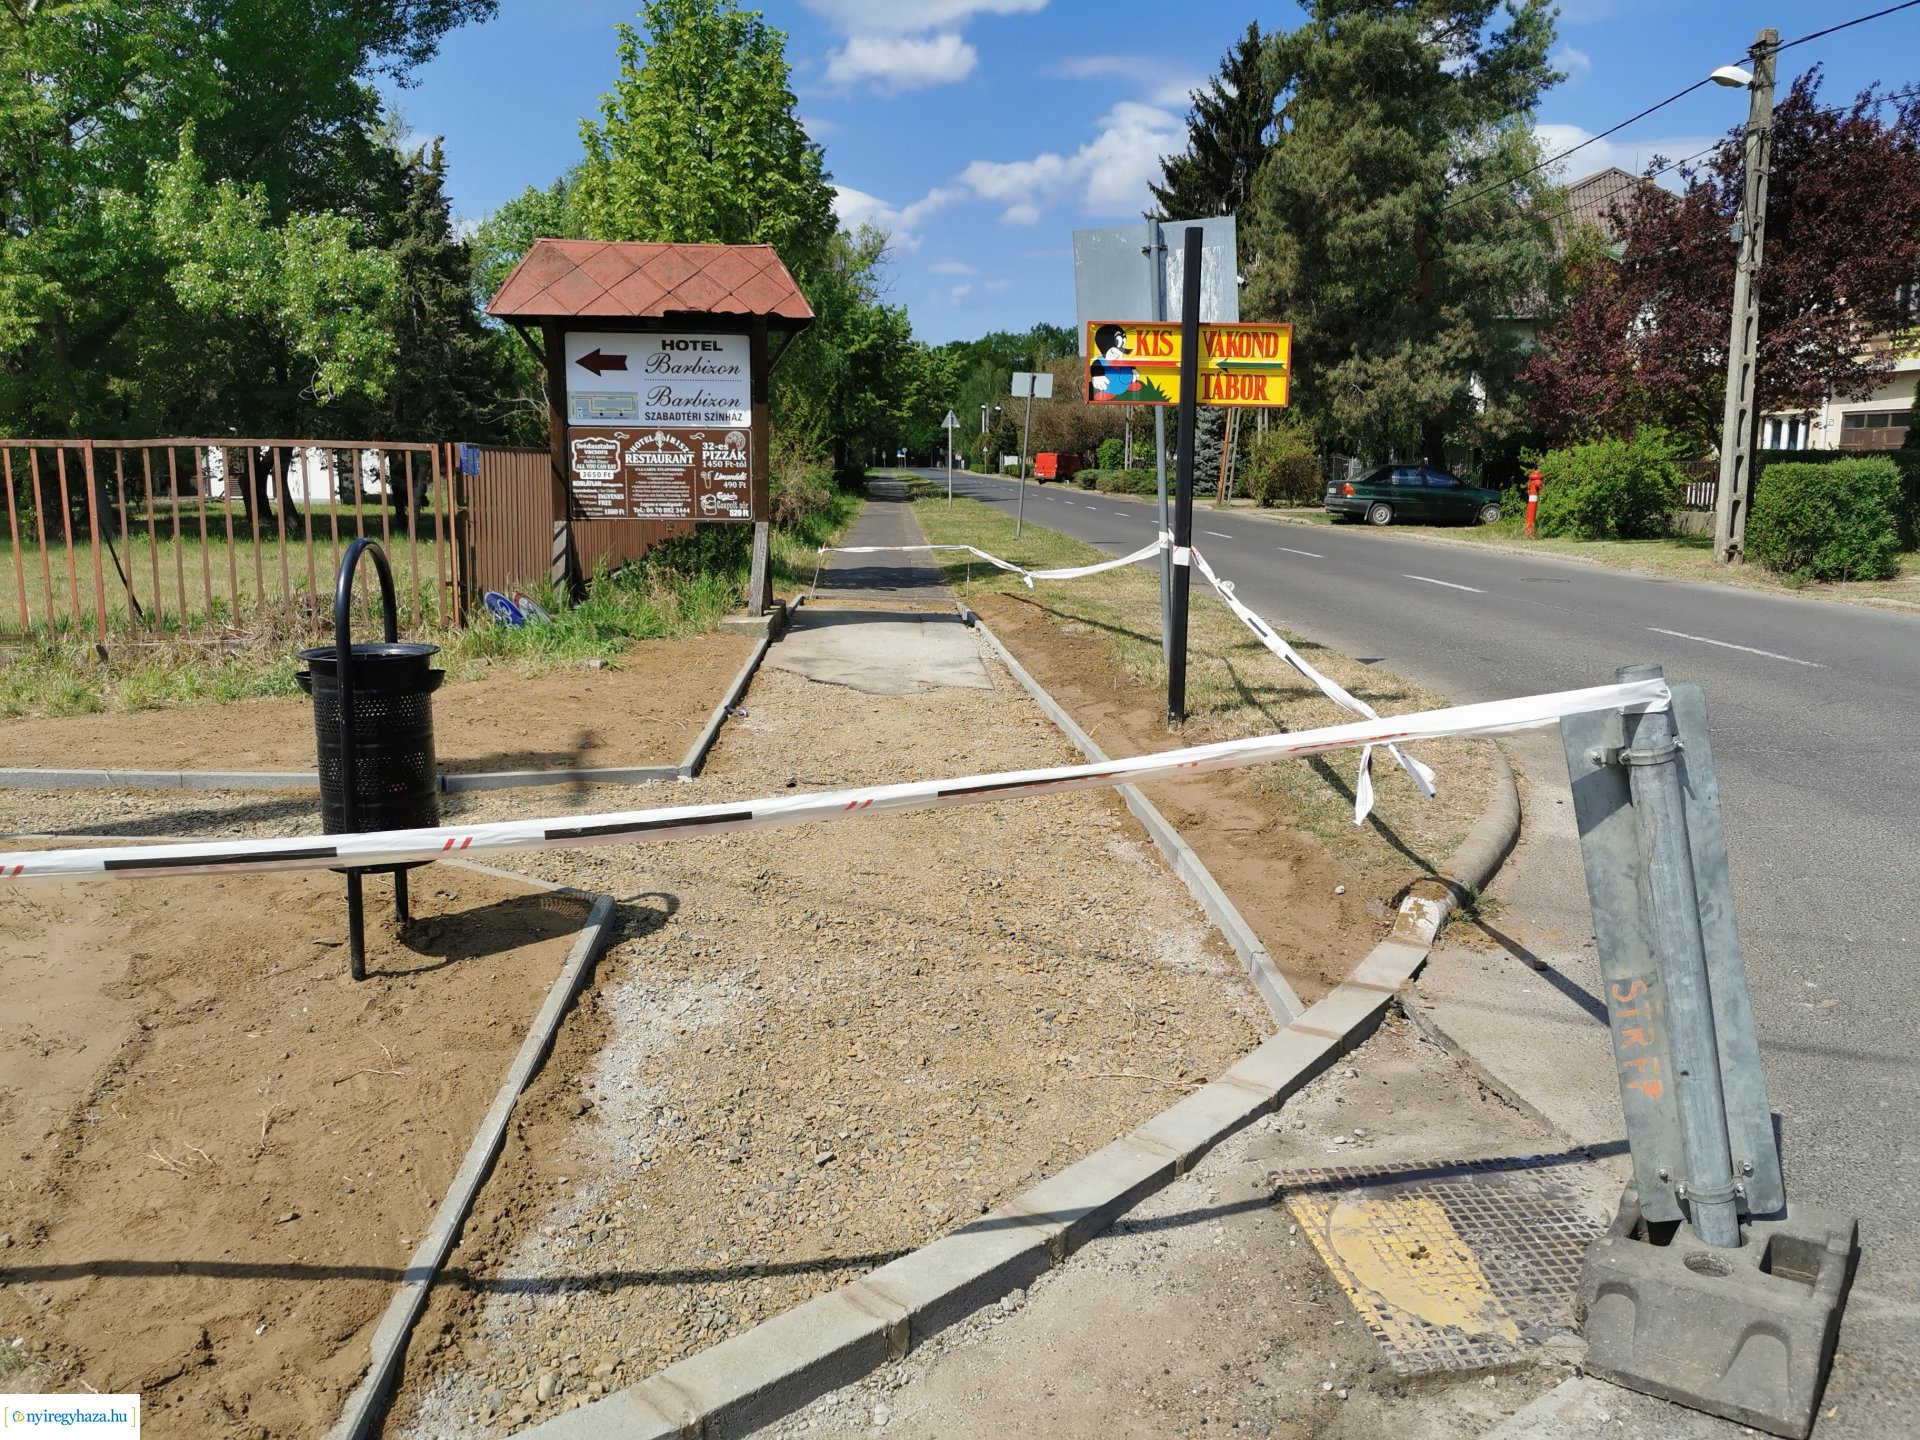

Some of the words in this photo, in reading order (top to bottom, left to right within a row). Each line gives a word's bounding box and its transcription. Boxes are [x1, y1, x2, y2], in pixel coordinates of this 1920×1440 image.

[661, 339, 723, 351] HOTEL
[1135, 329, 1174, 357] KIS
[1202, 330, 1280, 358] VAKOND
[645, 353, 741, 375] Barbizon
[1200, 371, 1270, 401] TÁBOR
[646, 386, 742, 408] Barbizon
[644, 410, 702, 422] SZABADTÉRI
[704, 411, 743, 422] SZÍNHÁZ
[629, 435, 655, 453] HOTEL
[666, 433, 690, 454] ÍRISZ
[702, 442, 729, 450] 32-es
[625, 453, 695, 464] RESTAURANT
[702, 449, 747, 460] PIZZÁK
[723, 481, 738, 489] 490
[738, 481, 747, 489] Ft
